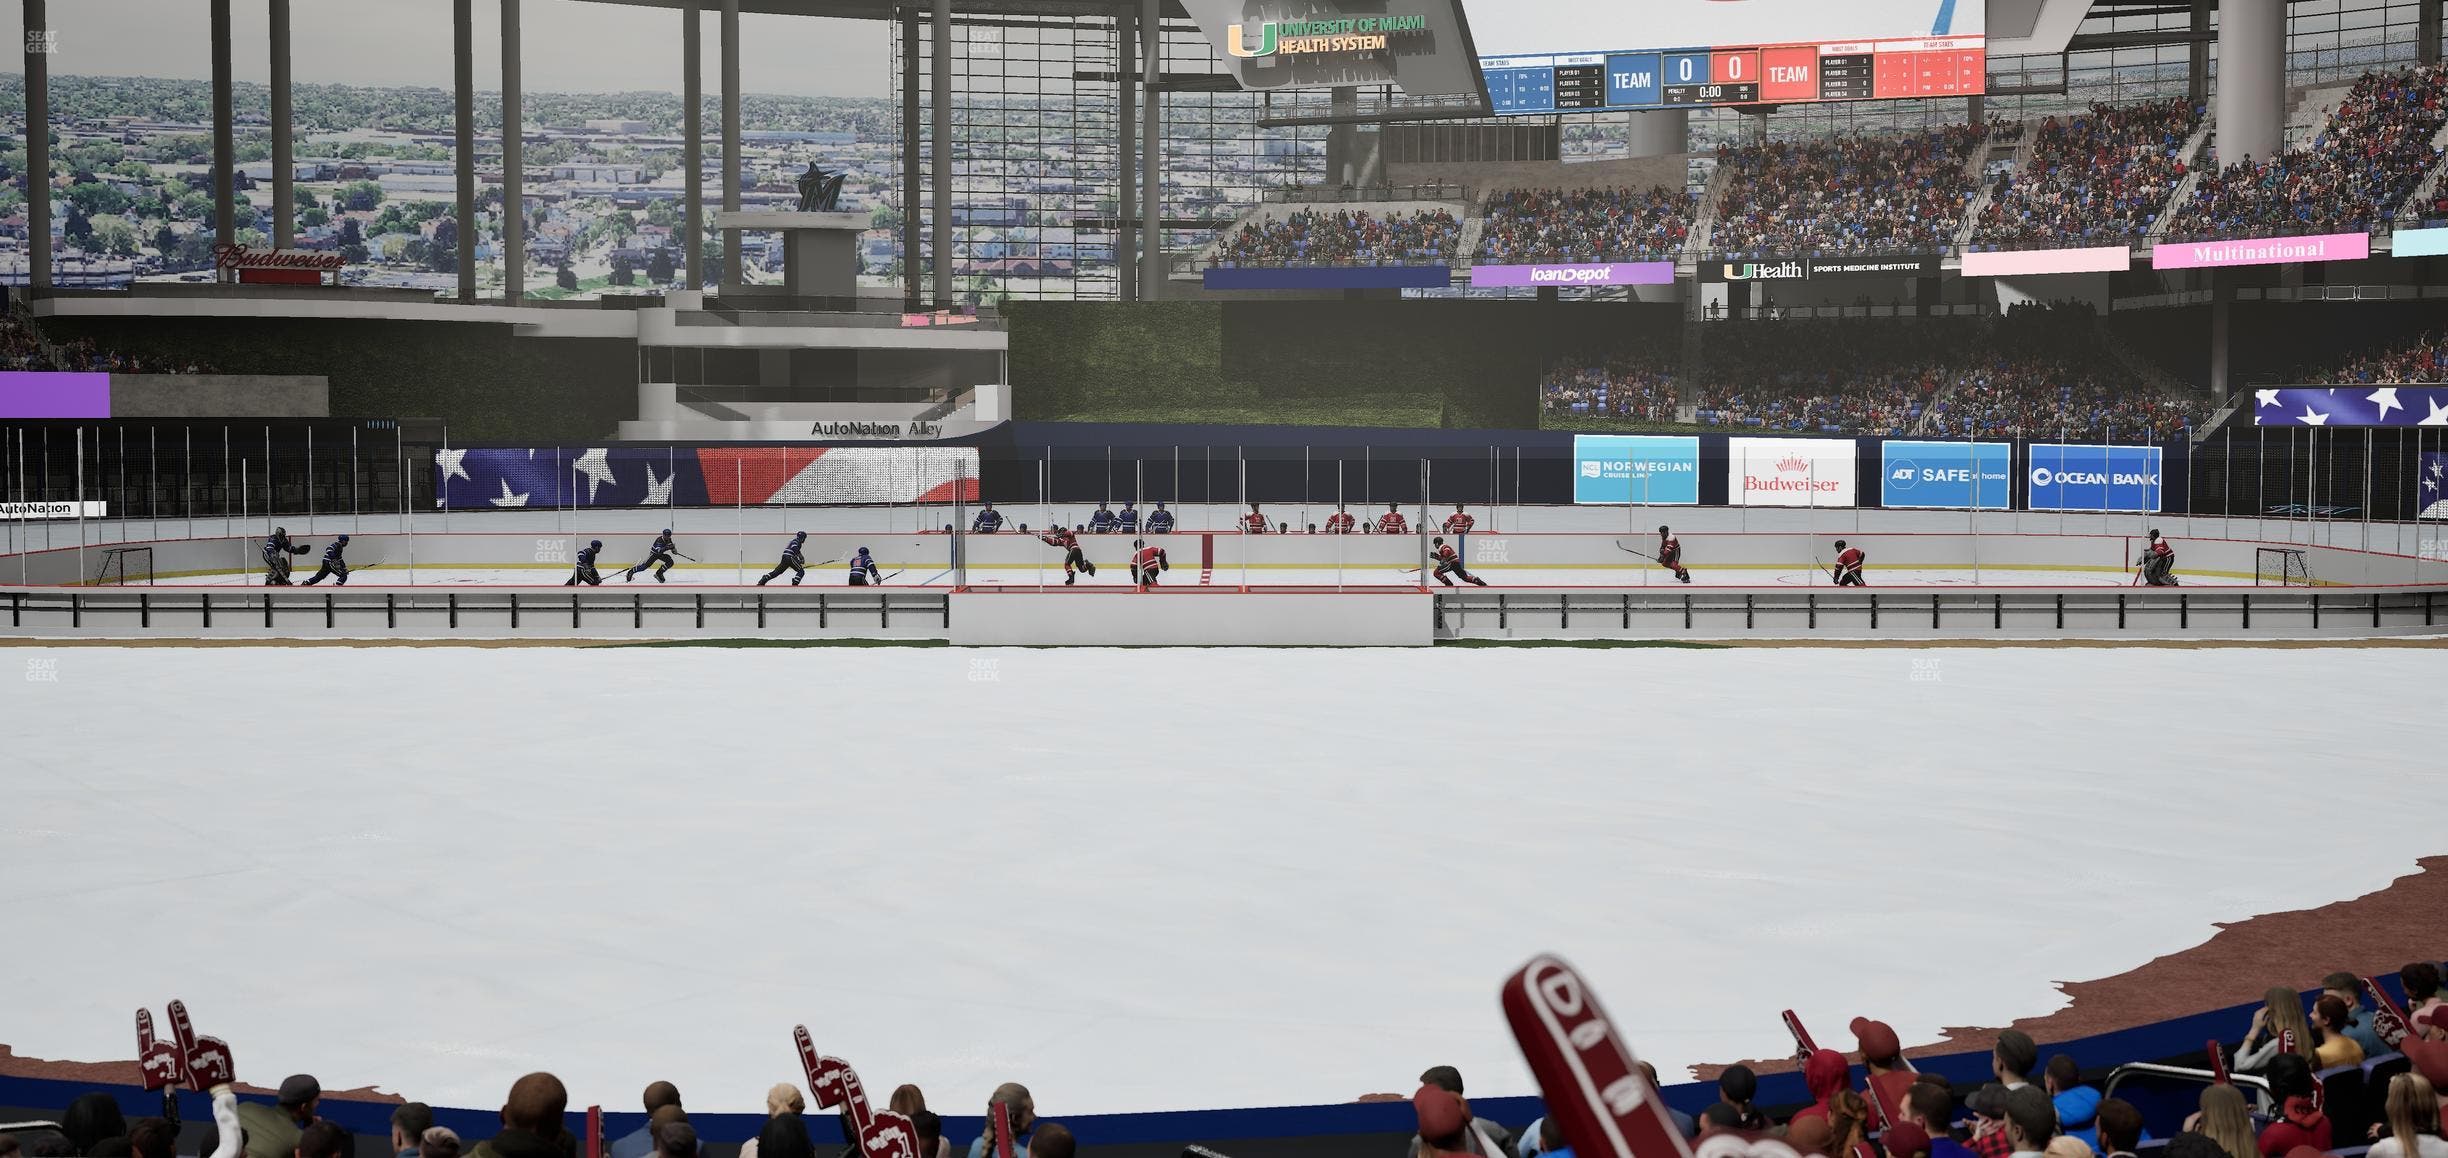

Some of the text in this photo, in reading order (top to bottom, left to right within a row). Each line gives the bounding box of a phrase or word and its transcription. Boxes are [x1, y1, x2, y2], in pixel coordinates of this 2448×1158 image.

[1279, 15, 1425, 37] UNIVERSITY OF MIAMI
[1279, 35, 1386, 54] HEALTH SYSTEM
[1680, 57, 1692, 81] 0
[1729, 56, 1741, 79] 0
[1769, 66, 1808, 83] TEAM
[1613, 72, 1651, 89] TEAM
[1700, 86, 1721, 97] 0:00
[213, 243, 347, 269] Budweiser
[2194, 241, 2324, 262] Multinational
[1531, 266, 1611, 283] loanDepot
[1843, 264, 1879, 272] MEDICINE
[1880, 263, 1920, 271] INSTITUTE
[811, 421, 943, 438] AutoNation Alley
[1603, 461, 1692, 472] NORWEGIAN
[1891, 469, 1915, 480] ADT
[1744, 476, 1839, 492] Budweiser
[1922, 469, 1969, 482] SAFE
[2055, 472, 2158, 485] OCEAN BANK
